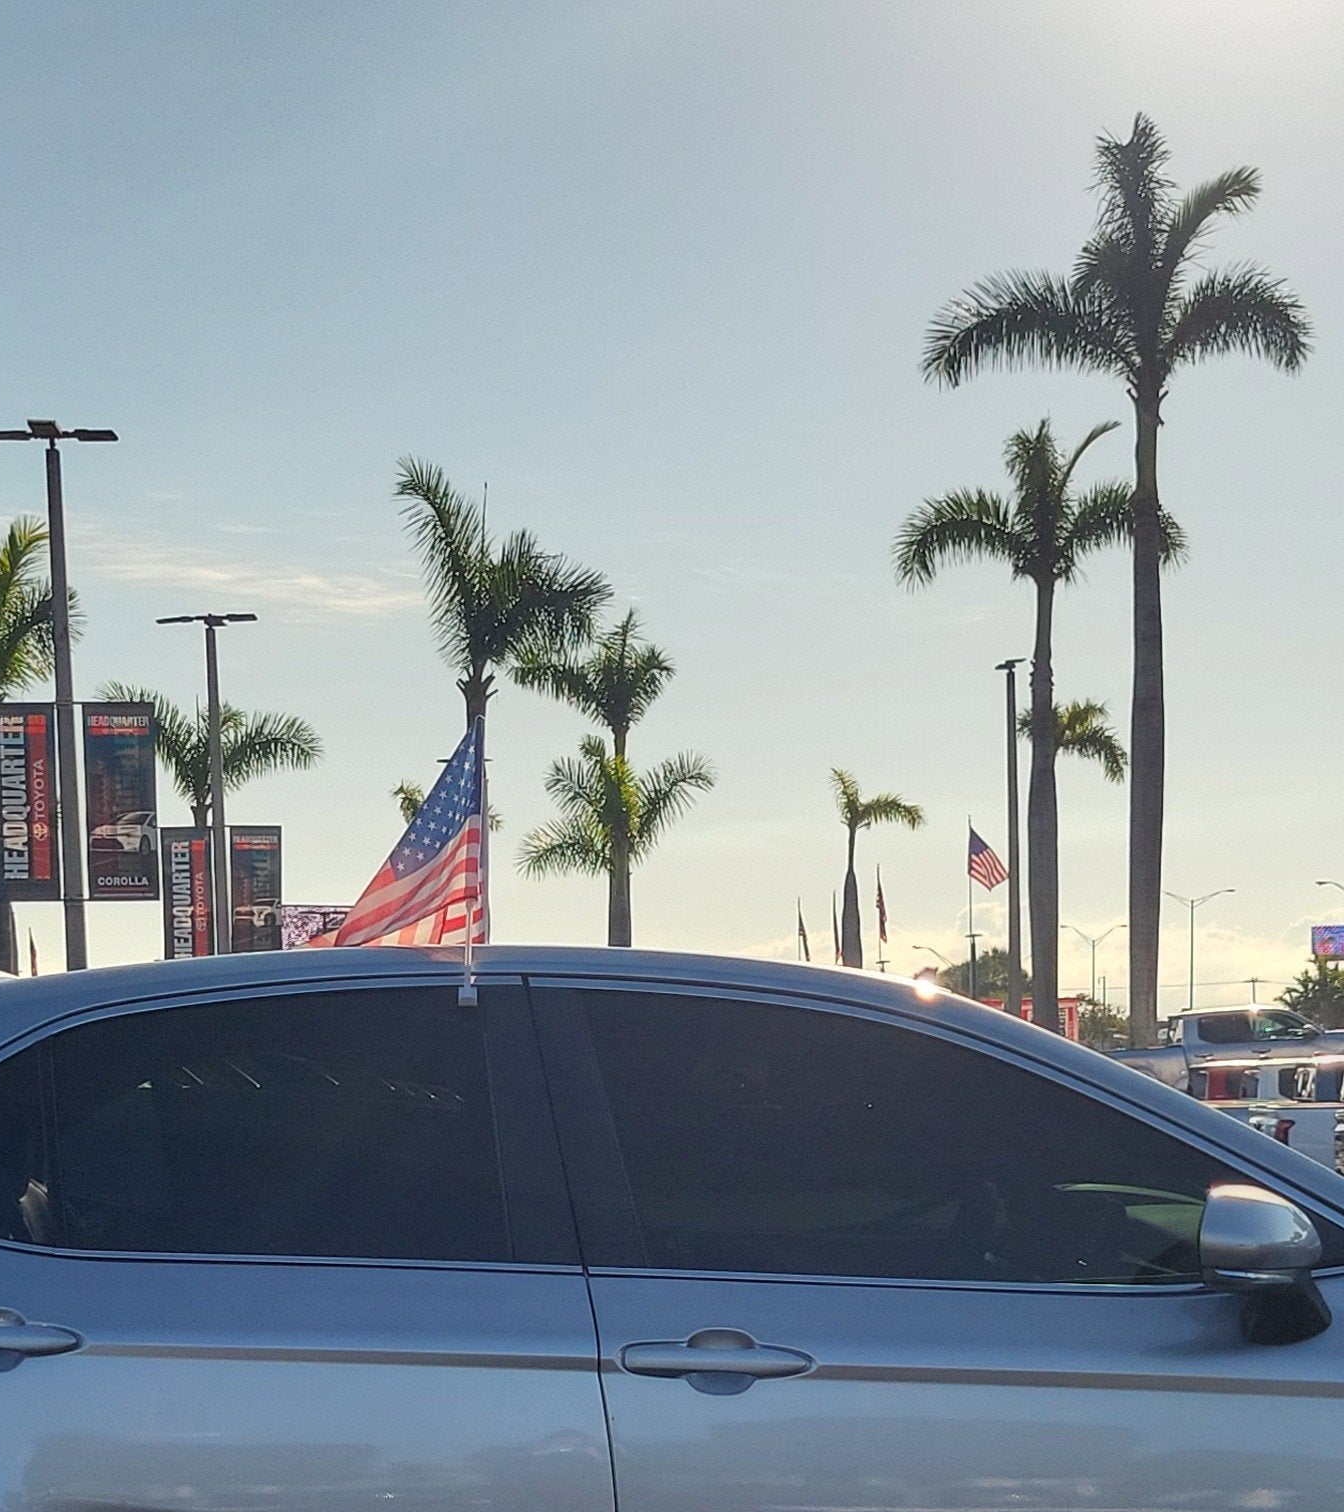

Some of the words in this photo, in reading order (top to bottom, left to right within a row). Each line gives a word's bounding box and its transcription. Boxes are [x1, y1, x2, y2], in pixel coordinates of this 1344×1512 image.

[0, 716, 30, 879] HEADQUARTER
[33, 759, 46, 820] TOYOTA
[98, 877, 149, 886] COROLLA
[172, 842, 193, 959] HEADQUARTER
[195, 872, 205, 915] TOYOTA
